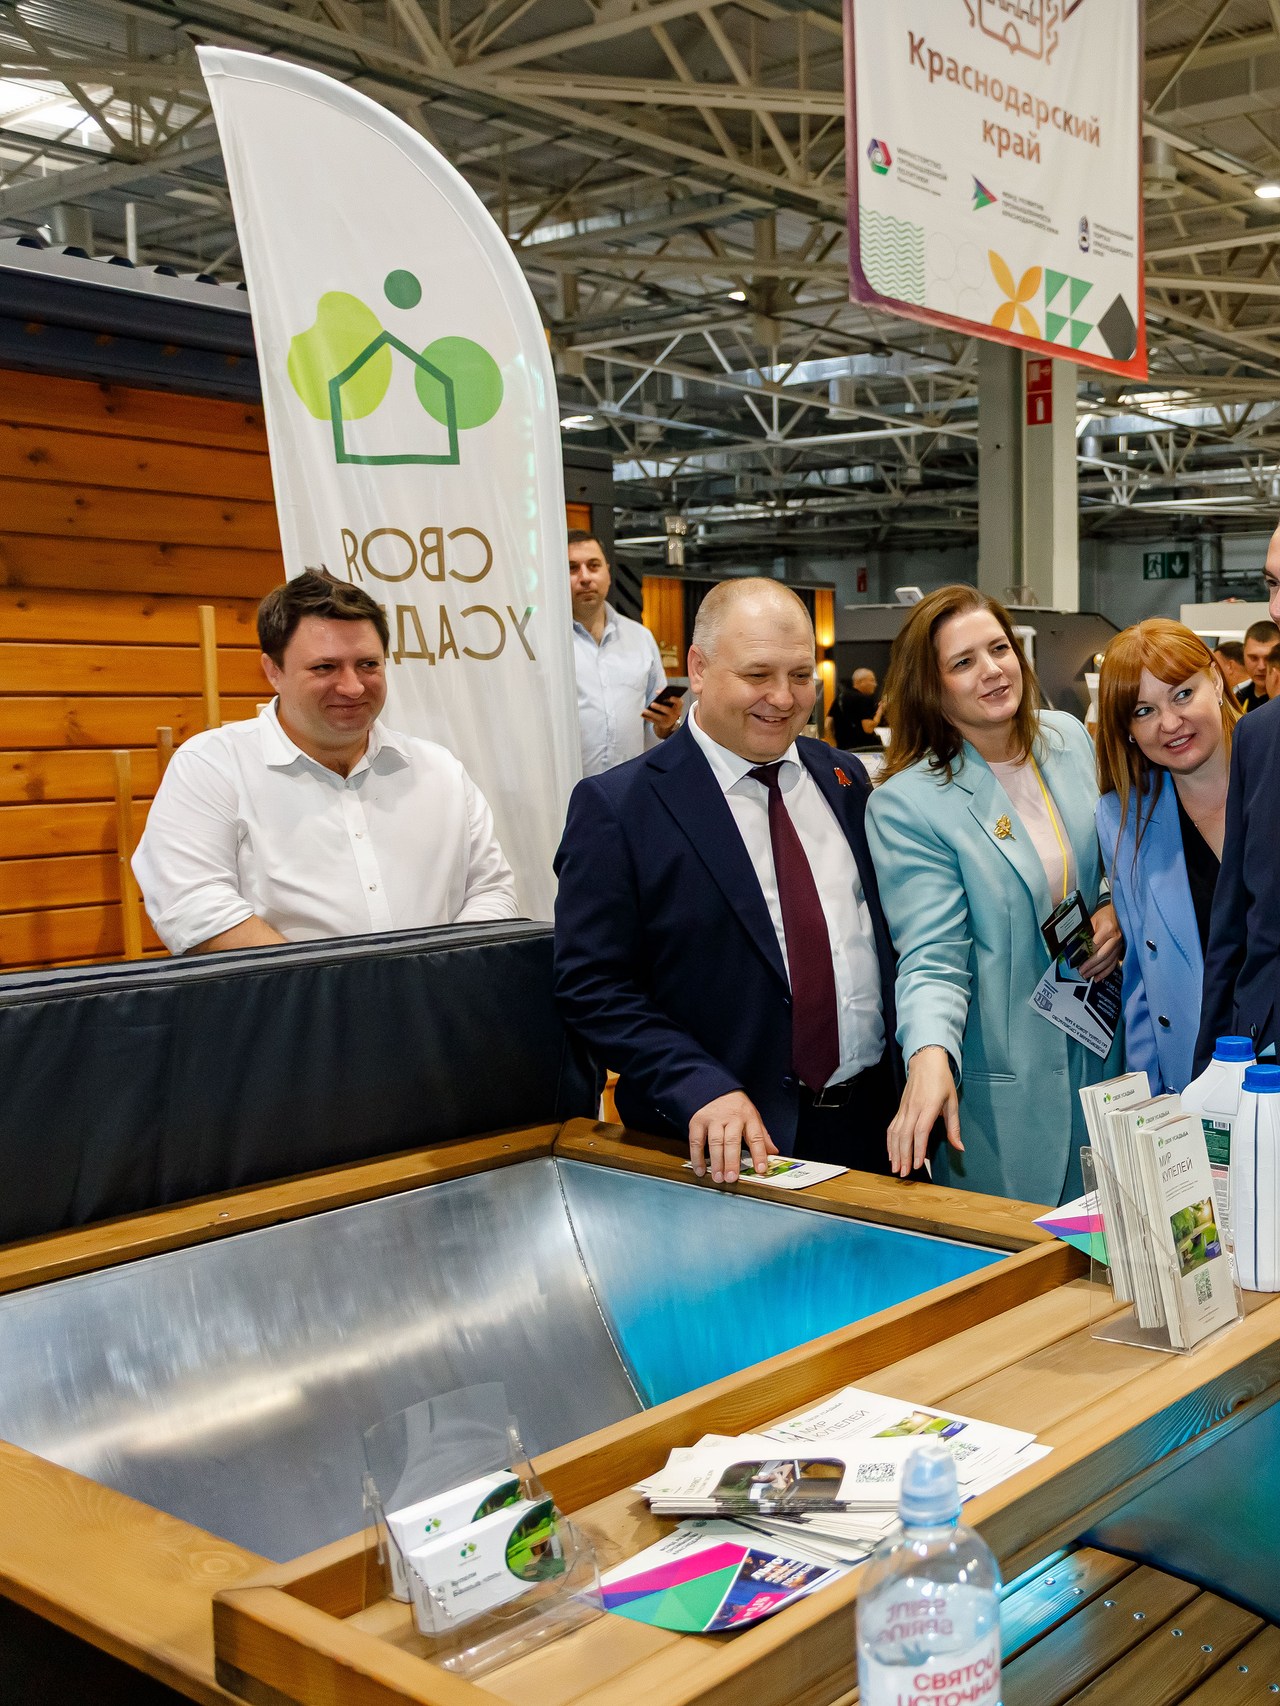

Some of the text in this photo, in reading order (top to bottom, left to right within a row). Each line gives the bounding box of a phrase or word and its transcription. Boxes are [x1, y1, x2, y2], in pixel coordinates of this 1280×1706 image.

[907, 30, 1101, 149] Краснодарский
[982, 118, 1041, 164] край
[1158, 1151, 1172, 1168] МИР
[1161, 1156, 1193, 1184] КУПЕЛЕЙ
